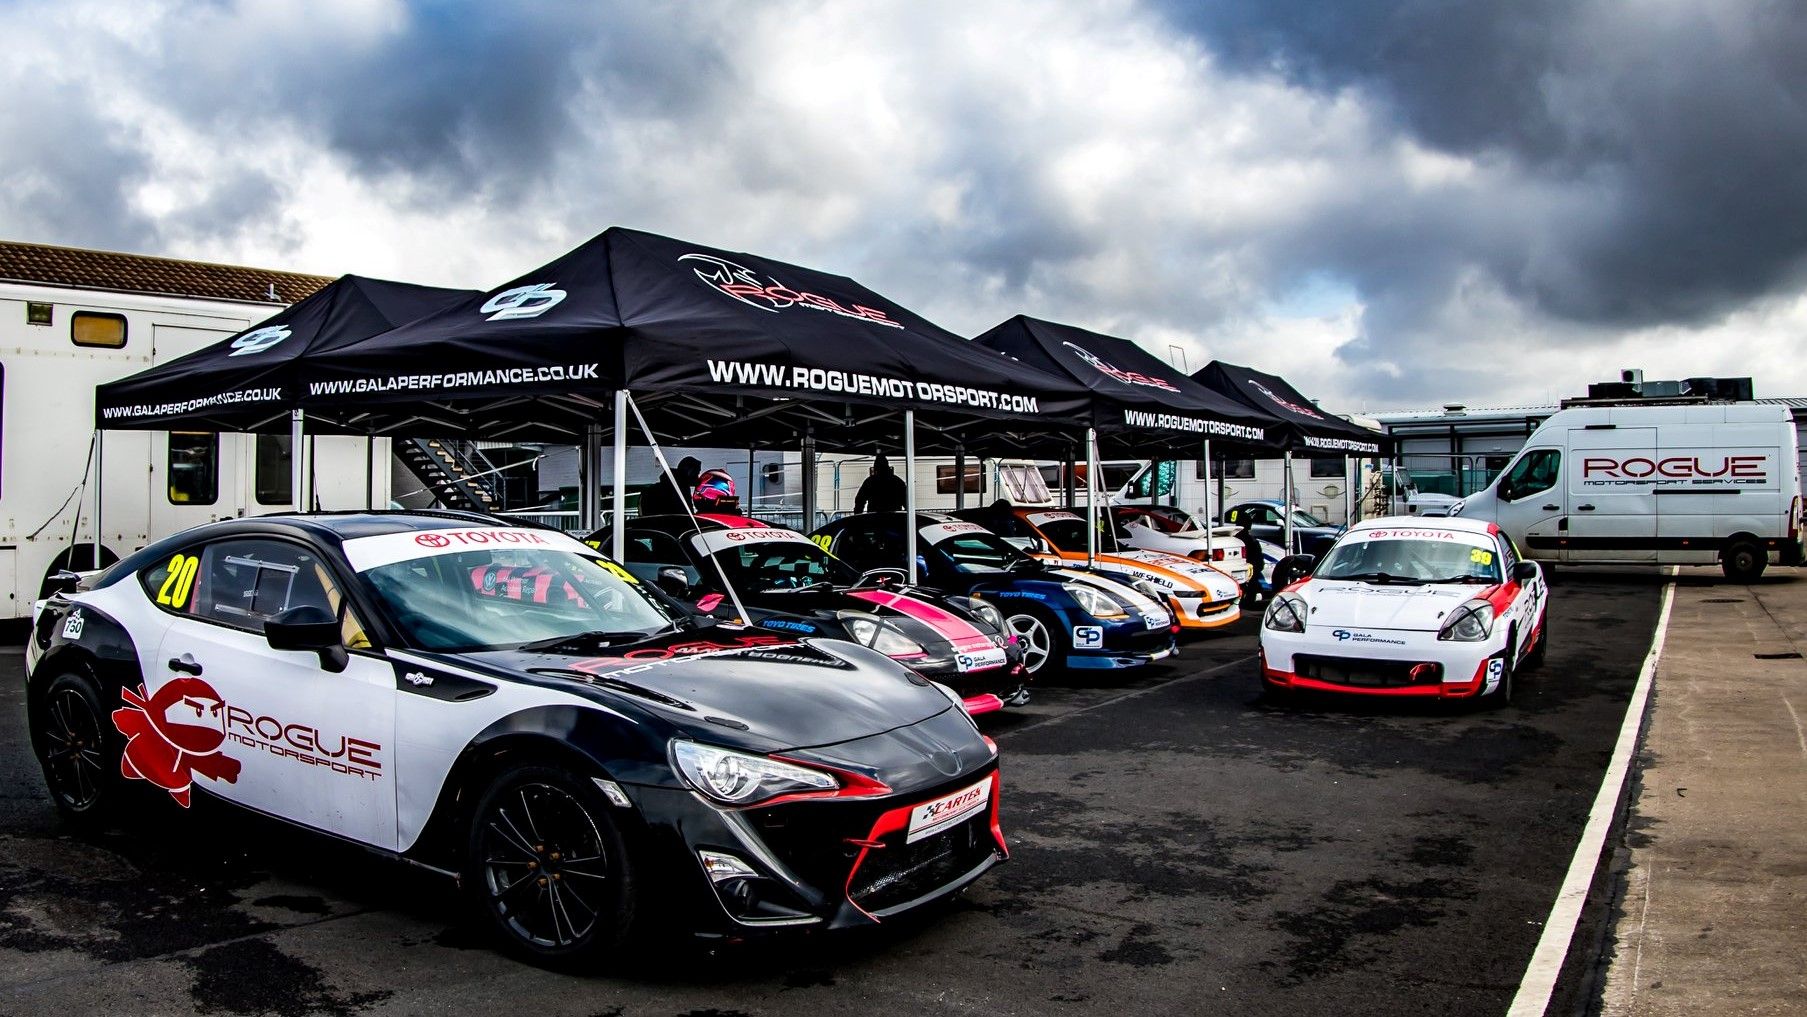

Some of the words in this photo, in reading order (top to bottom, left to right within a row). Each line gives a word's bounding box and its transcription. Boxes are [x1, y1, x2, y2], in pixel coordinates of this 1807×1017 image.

[310, 363, 599, 395] WWW.GALAPERFORMANCE.CO.UK
[103, 387, 282, 419] WWW.GALAPERFORMANCE.CO.UK
[1584, 456, 1767, 478] ROGUE
[447, 531, 550, 545] TOYOTA
[743, 531, 800, 540] TOYOTA
[1391, 530, 1454, 540] TOYOTA
[157, 553, 199, 608] 20
[763, 620, 786, 628] TOYO
[1352, 637, 1406, 645] PERFORMANCE
[228, 705, 382, 769] ROGUE
[228, 731, 382, 781] MOTORSPORT
